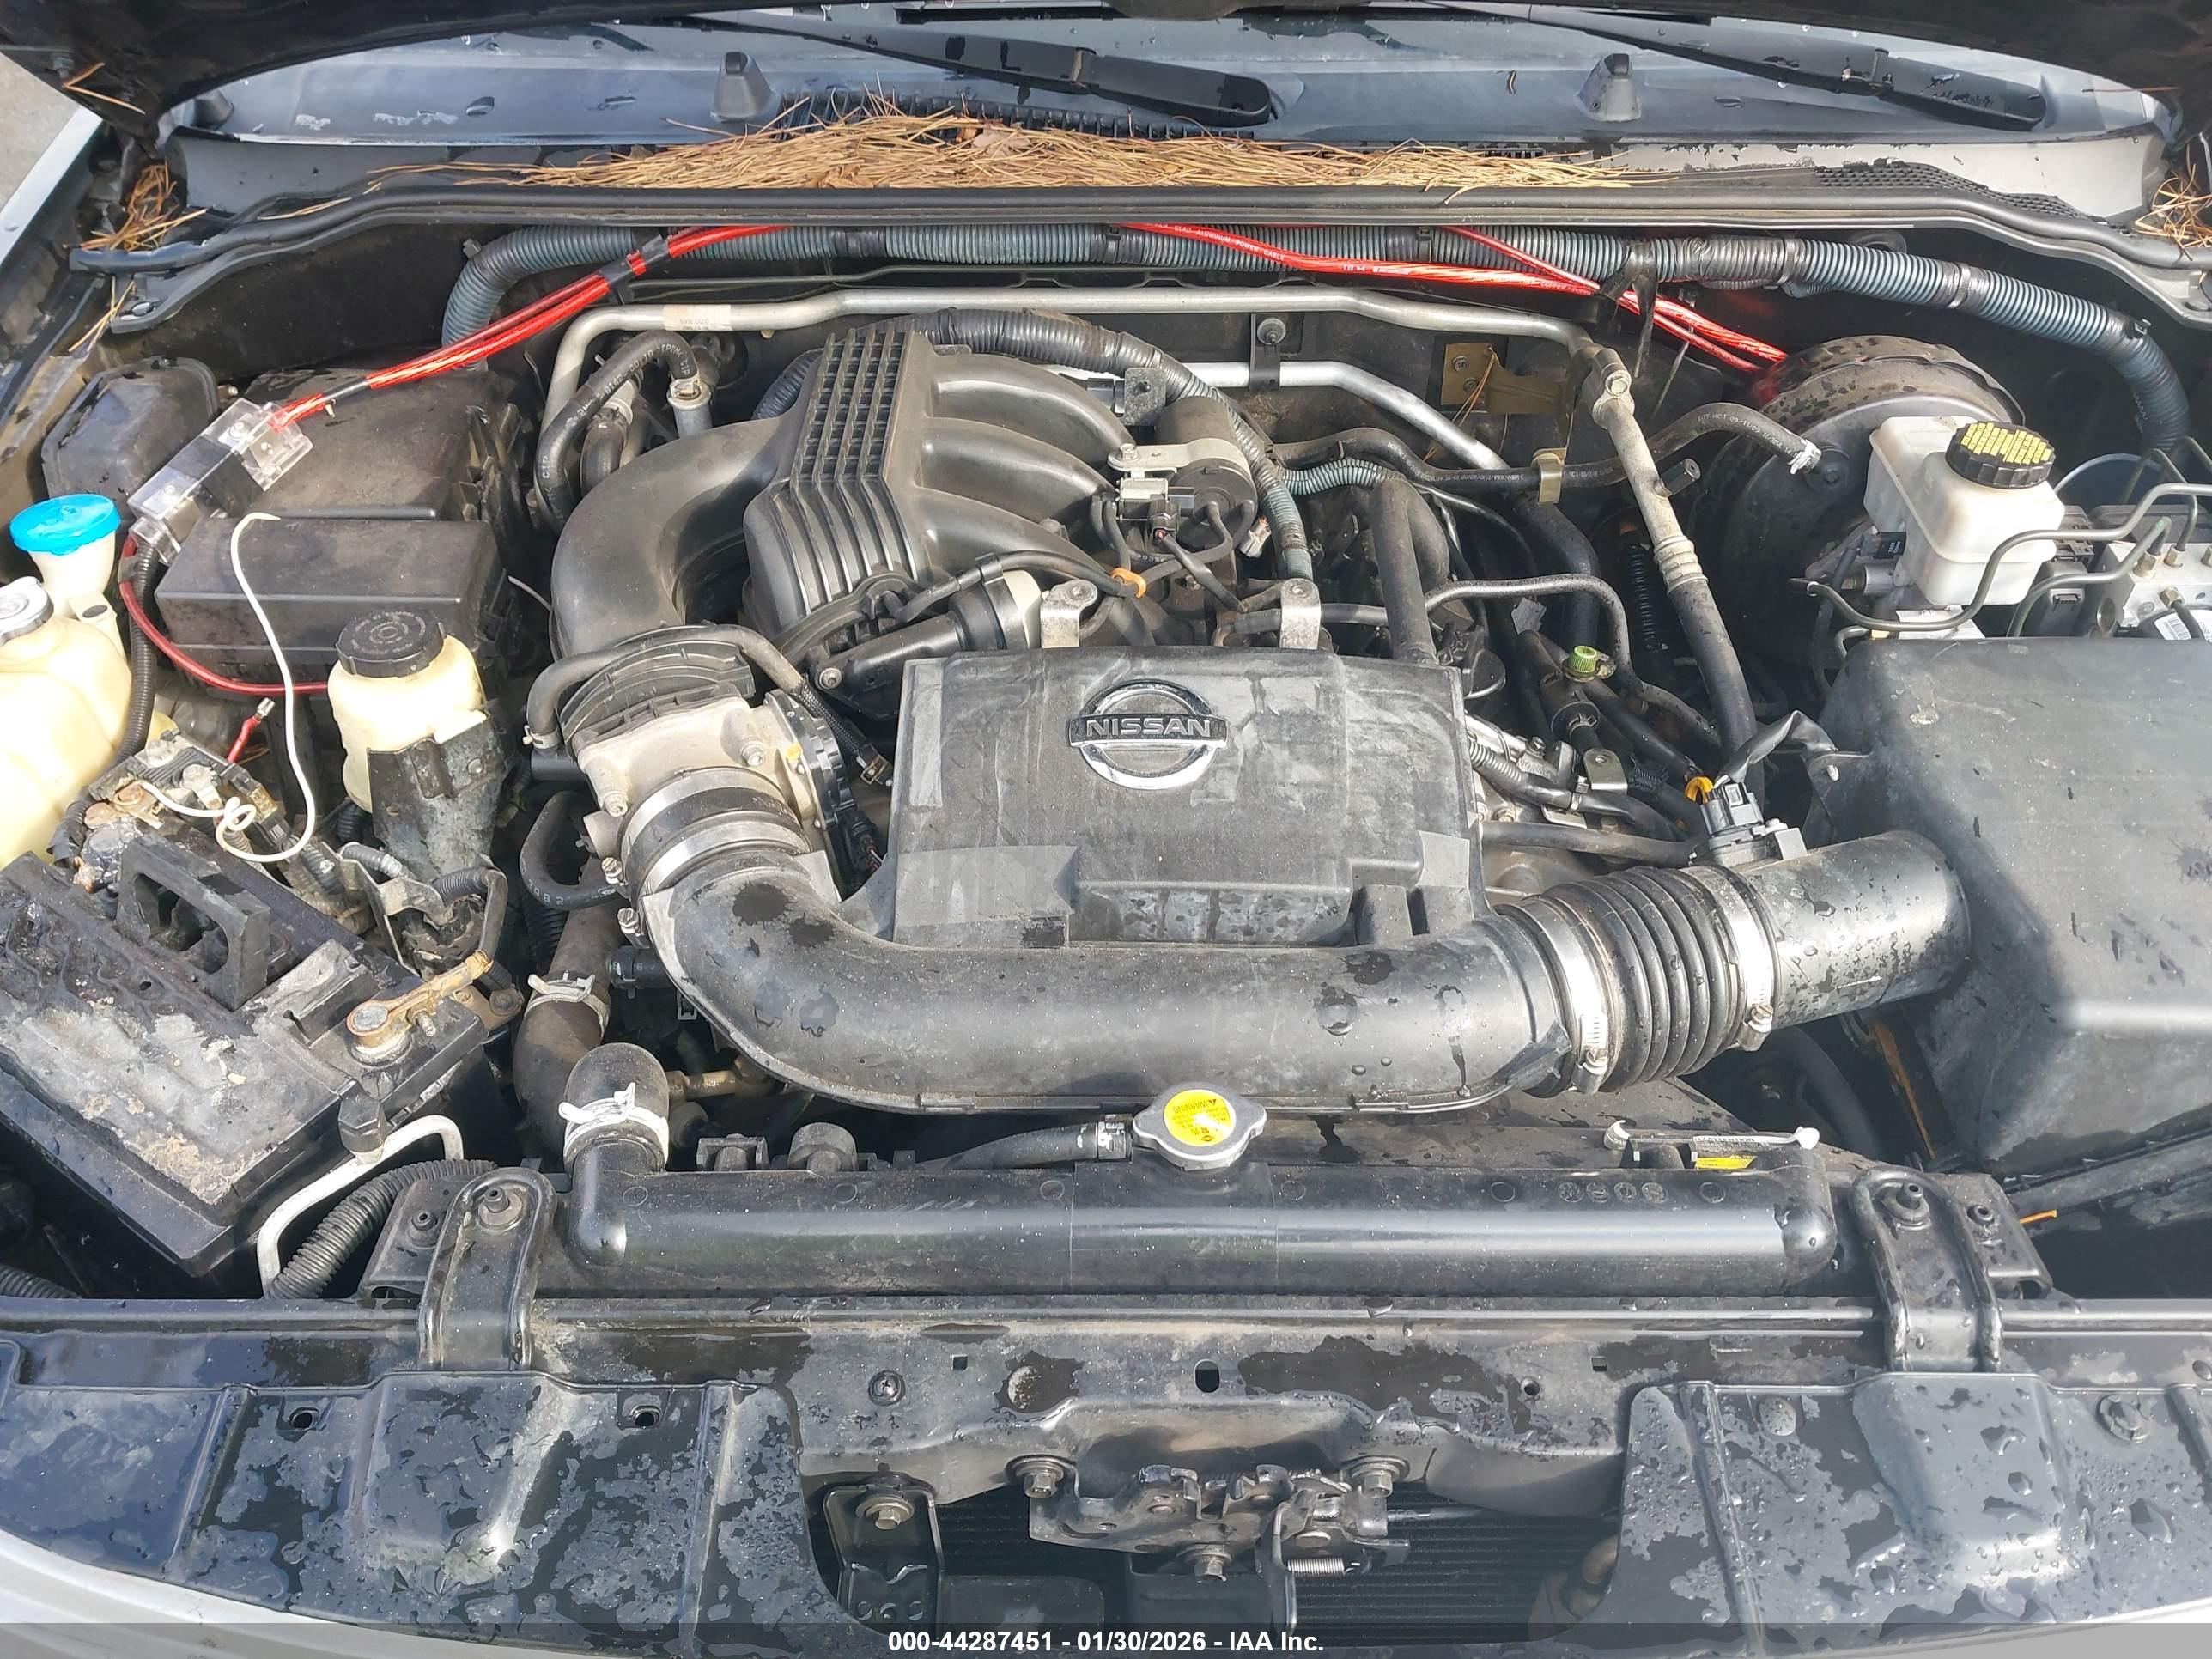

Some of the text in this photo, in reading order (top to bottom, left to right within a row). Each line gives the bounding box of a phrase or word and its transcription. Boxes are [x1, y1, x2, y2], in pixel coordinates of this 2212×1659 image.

[1196, 229, 1231, 243] ALUMINUM
[1235, 239, 1260, 252] POWER
[1263, 249, 1285, 261] CABLE
[1086, 718, 1211, 738] NISSAN
[1173, 1100, 1208, 1114] WARNING
